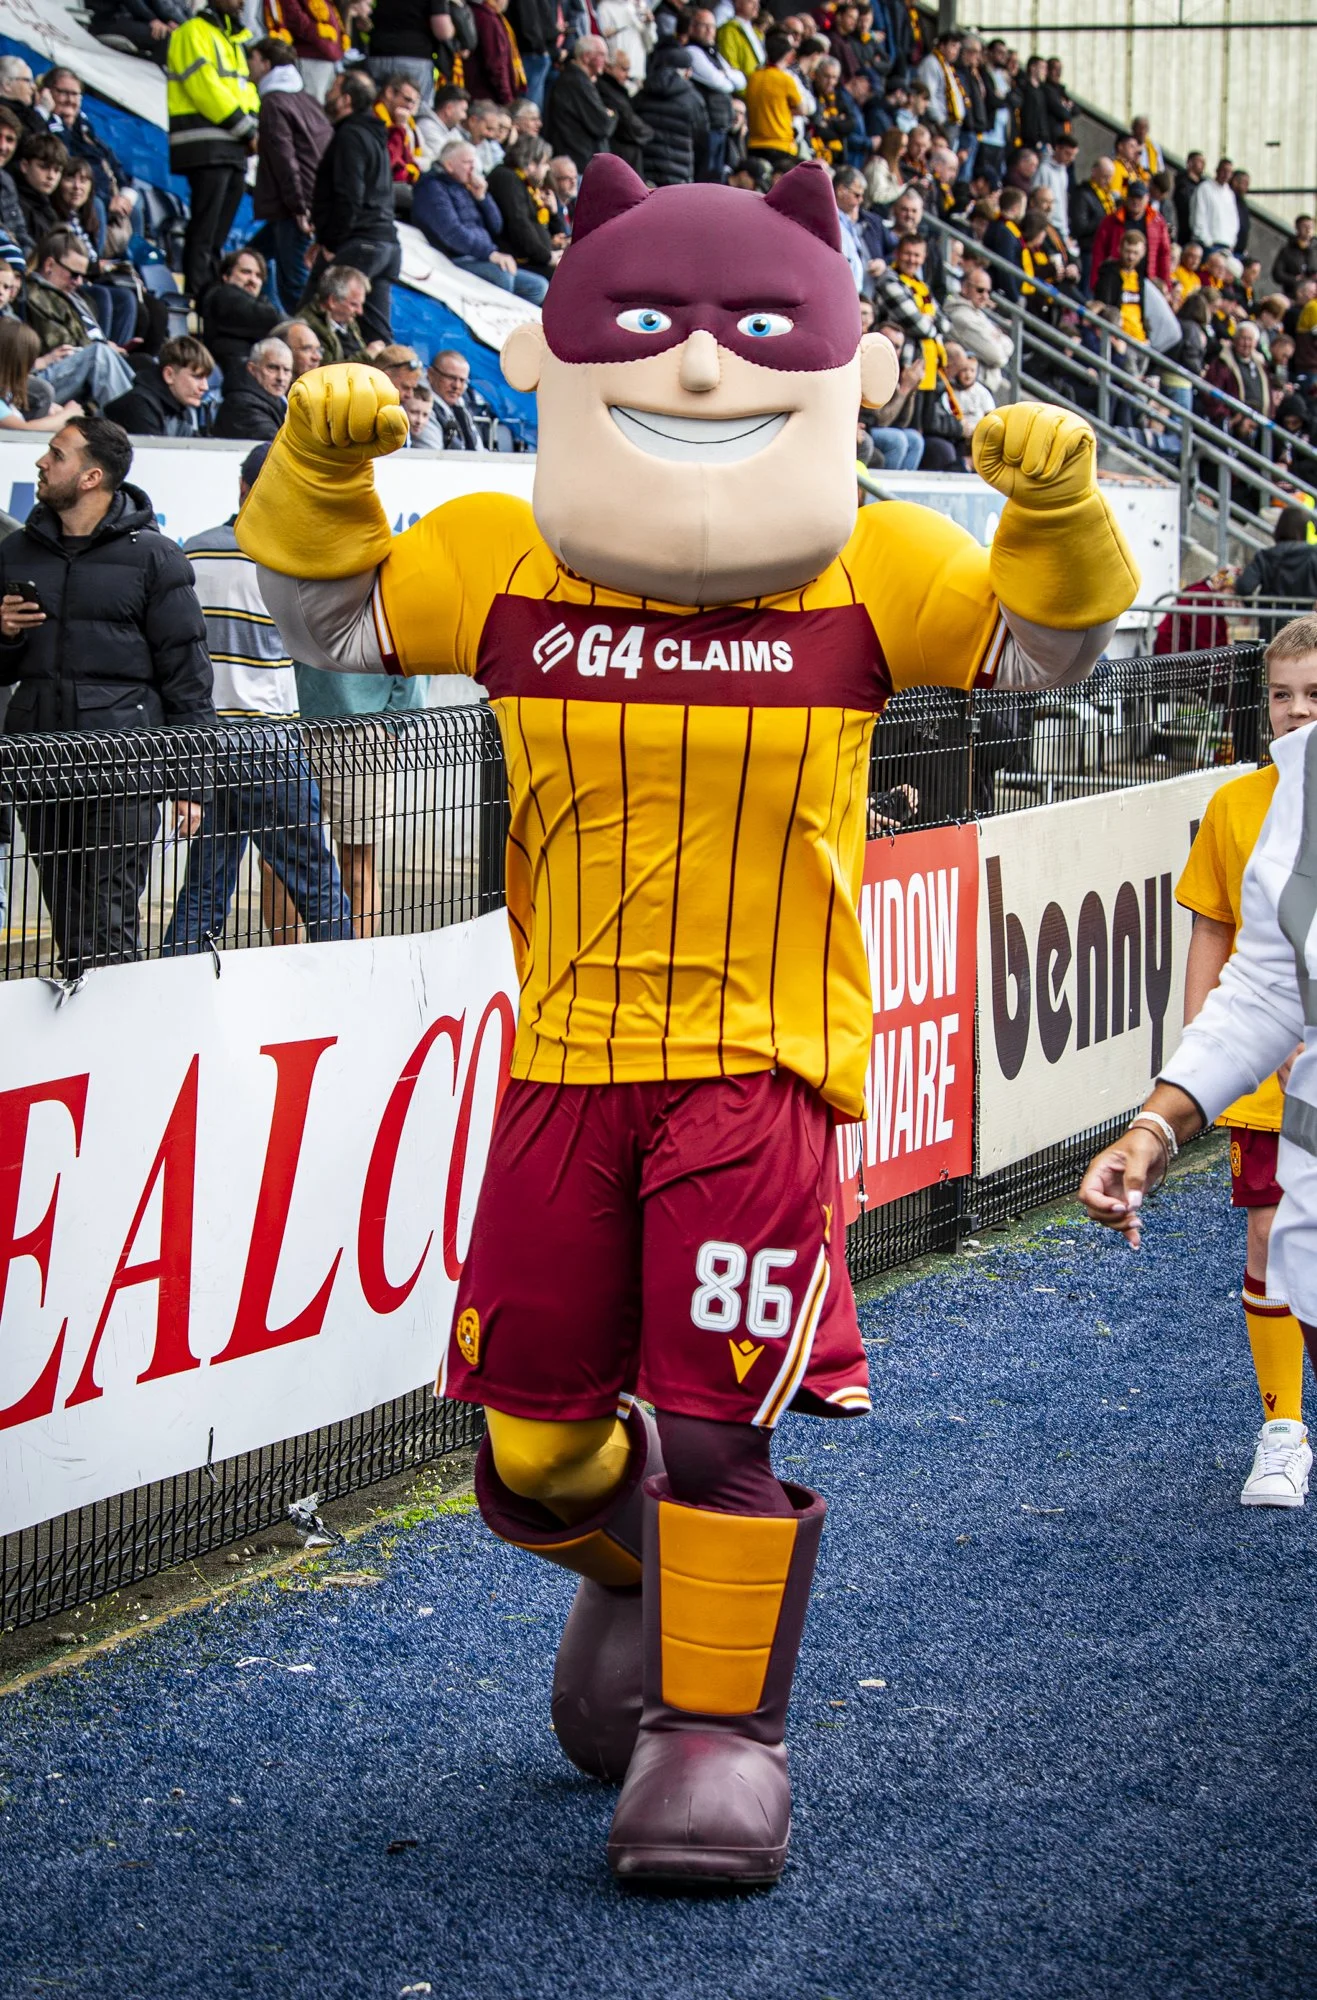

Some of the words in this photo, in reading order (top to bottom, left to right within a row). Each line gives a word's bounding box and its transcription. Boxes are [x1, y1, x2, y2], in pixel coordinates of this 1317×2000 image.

[576, 624, 646, 680] G4
[653, 637, 795, 673] CLAIMS
[855, 866, 960, 1014] NDOW
[985, 855, 1172, 1080] benny
[835, 1012, 960, 1184] WARE
[690, 1240, 798, 1338] 86
